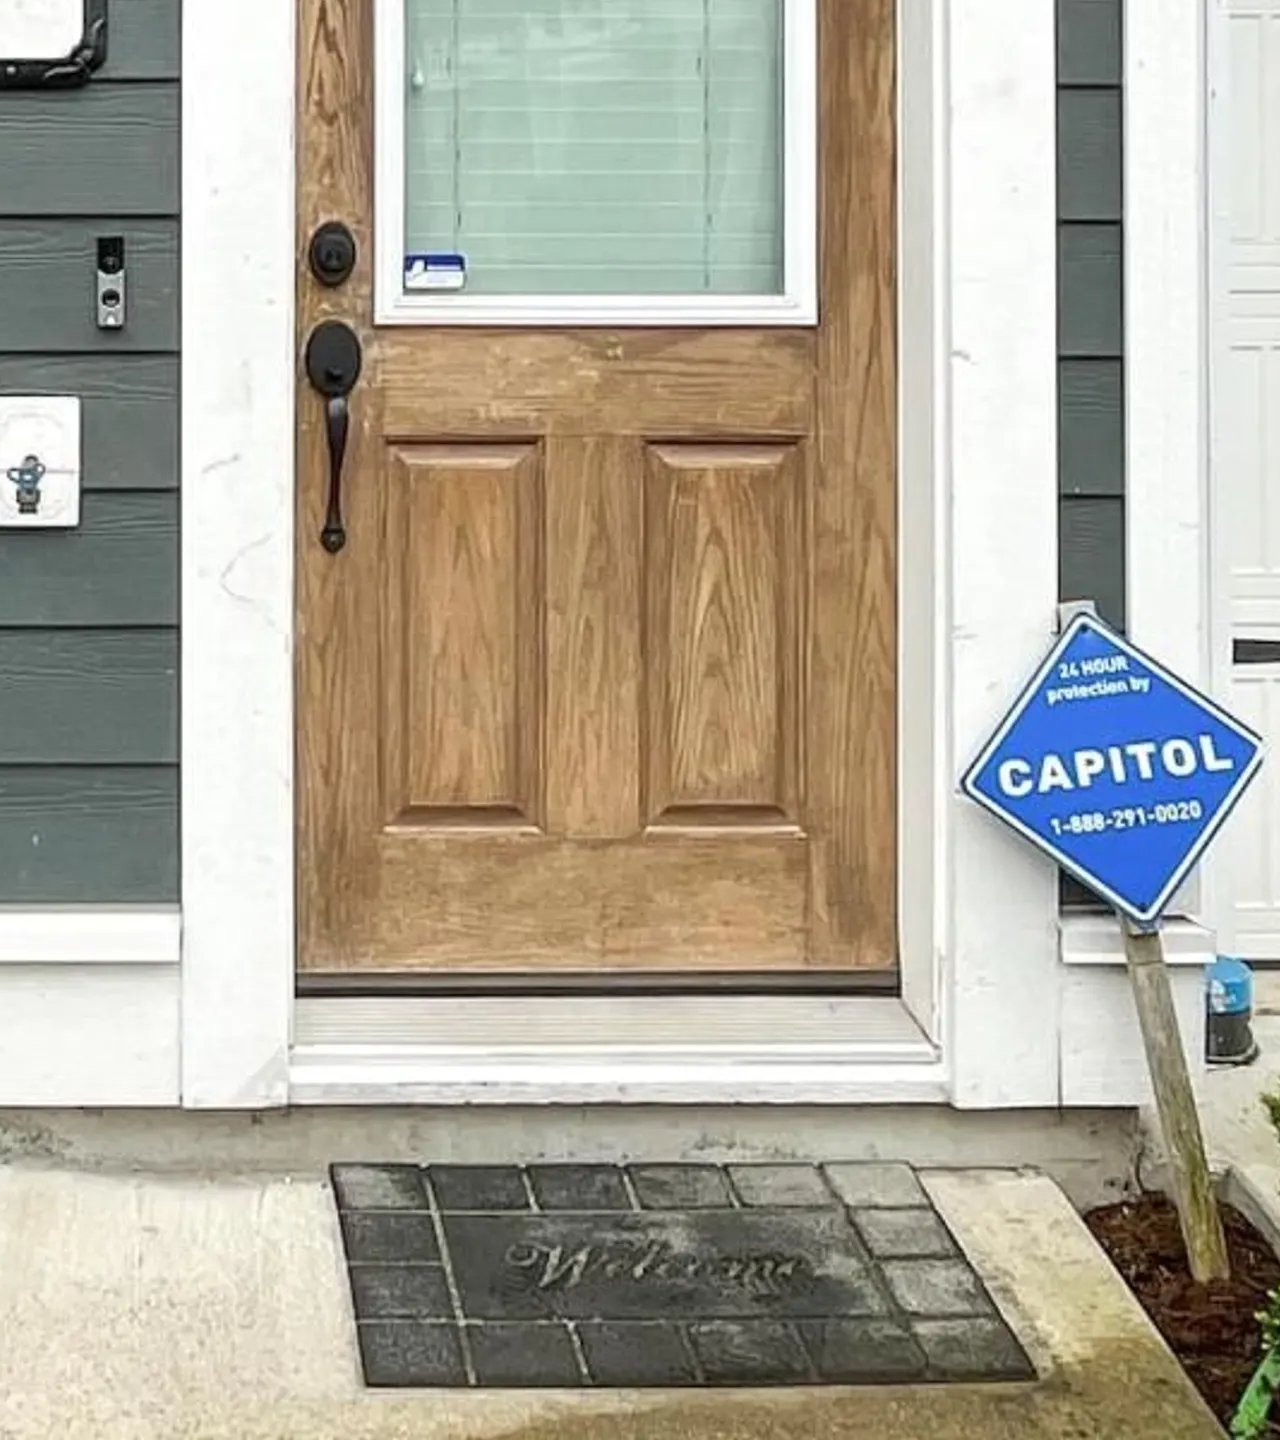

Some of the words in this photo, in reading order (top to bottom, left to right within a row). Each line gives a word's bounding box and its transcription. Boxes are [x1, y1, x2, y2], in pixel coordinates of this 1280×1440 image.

[1059, 662, 1080, 678] 24
[1081, 655, 1129, 676] HOUR
[1046, 679, 1128, 706] protection
[1129, 675, 1150, 693] by
[998, 734, 1233, 797] CAPITOL
[1050, 800, 1202, 835] 1-888-291-0020
